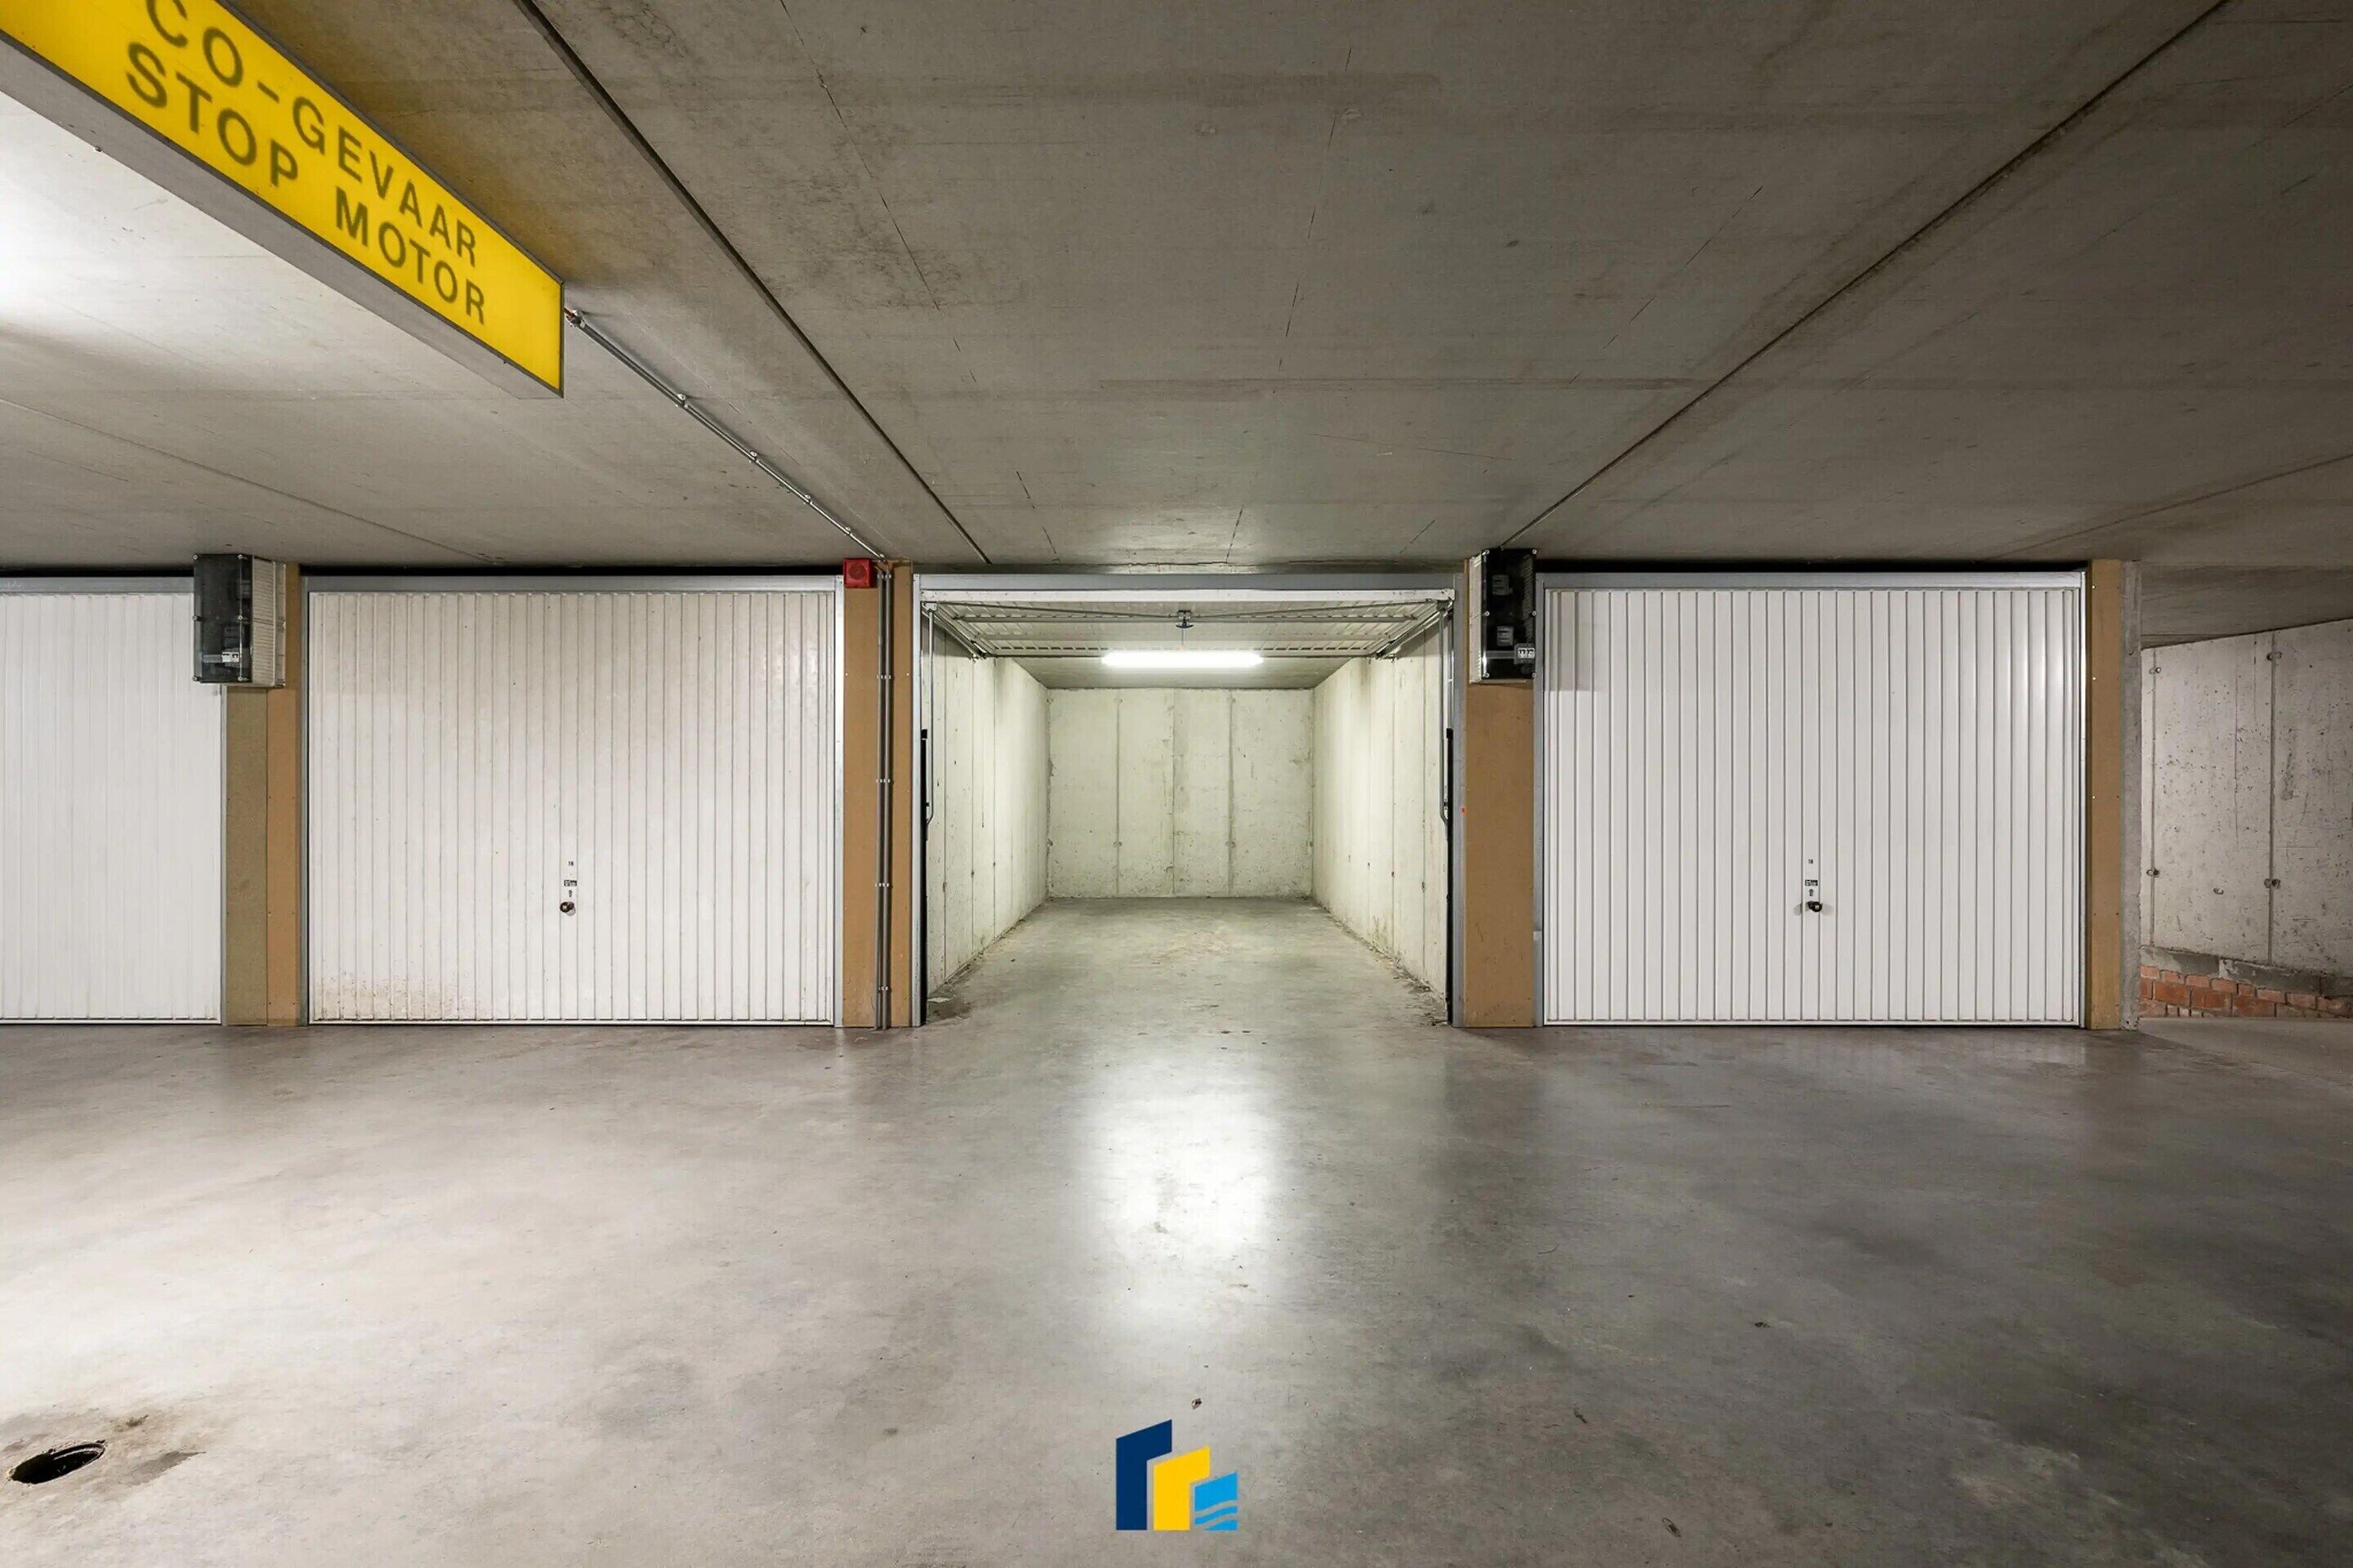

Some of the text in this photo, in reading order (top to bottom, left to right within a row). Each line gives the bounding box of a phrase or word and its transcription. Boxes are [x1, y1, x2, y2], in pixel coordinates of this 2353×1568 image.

[126, 42, 484, 325] STOP MOTOR
[145, 0, 476, 267] CO-GEVAAR
